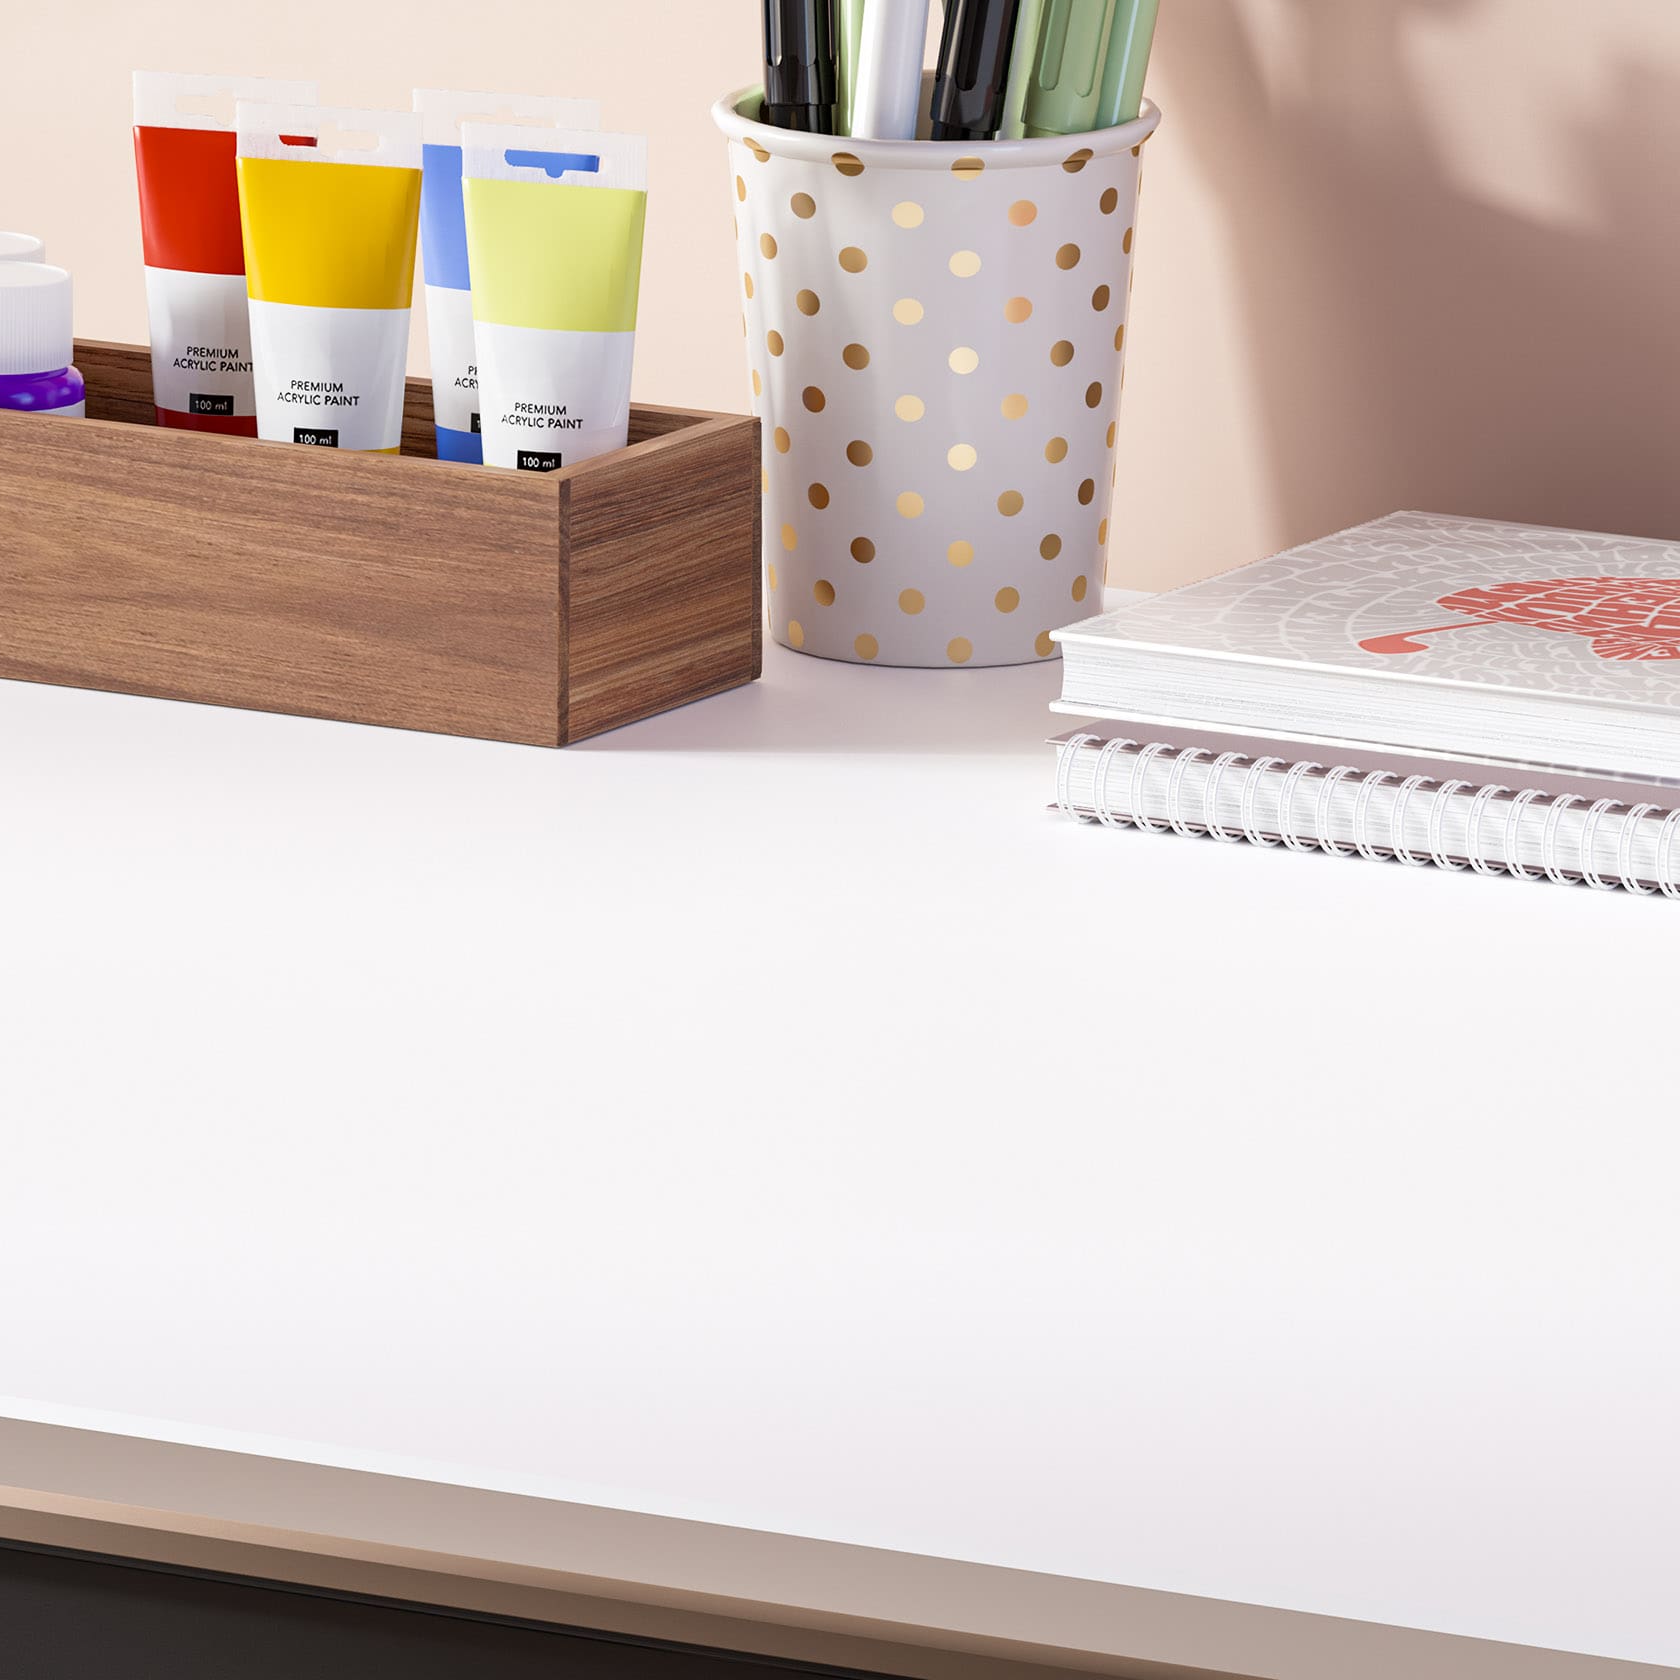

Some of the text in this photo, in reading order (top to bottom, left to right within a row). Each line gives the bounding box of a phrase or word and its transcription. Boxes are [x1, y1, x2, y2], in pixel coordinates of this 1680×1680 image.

[186, 346, 240, 359] PREMIUM
[173, 358, 254, 373] ACRYLIC PAINT
[290, 379, 344, 393] PREMIUM
[195, 400, 228, 411] 100 ml
[277, 391, 360, 407] ACRYLIC PAINT
[514, 402, 567, 416] PREMIUM
[501, 414, 584, 430] ACRYLIC PAINT
[299, 433, 317, 445] 100
[522, 456, 556, 469] 100 ml
